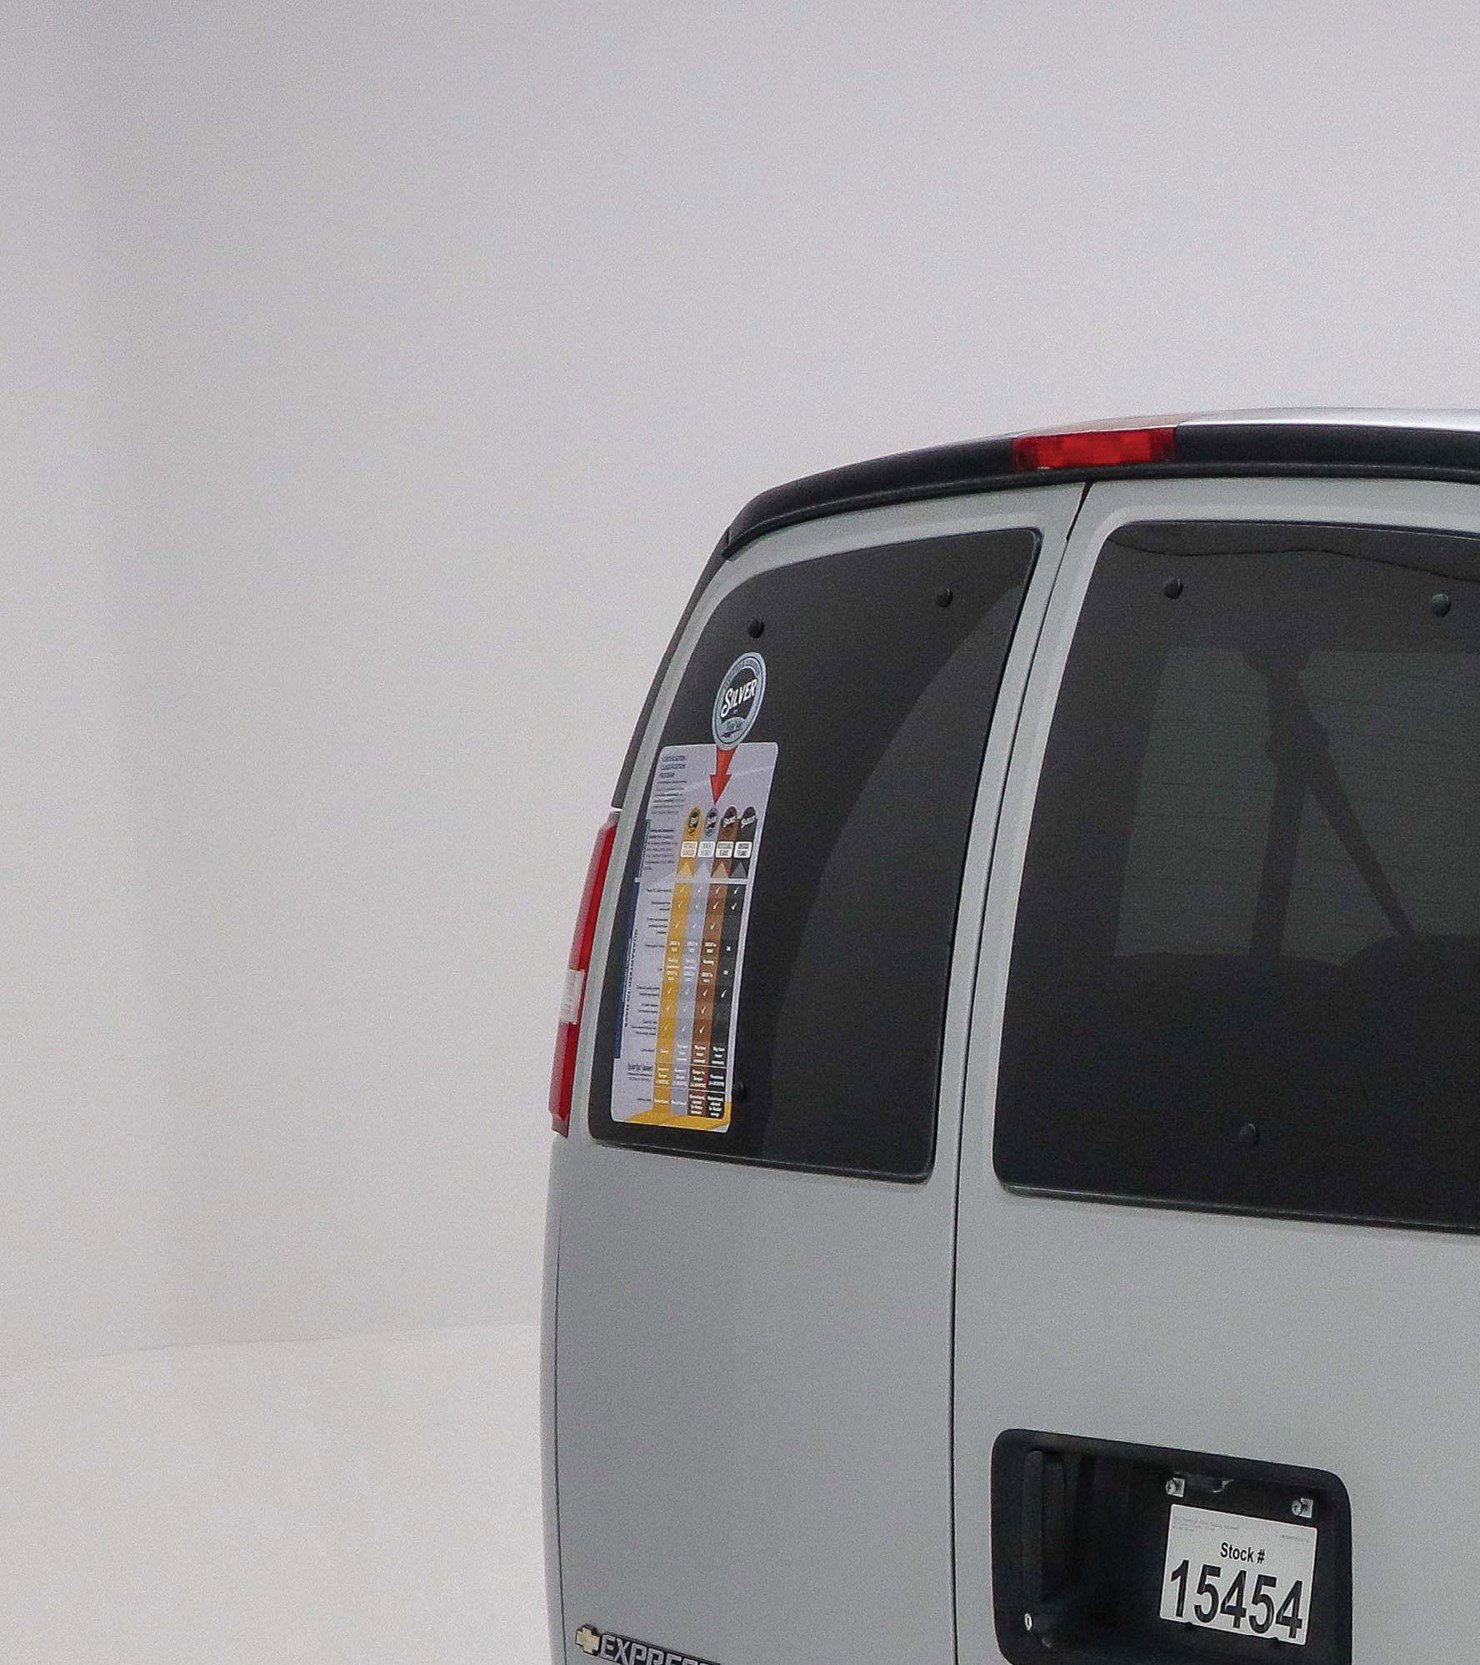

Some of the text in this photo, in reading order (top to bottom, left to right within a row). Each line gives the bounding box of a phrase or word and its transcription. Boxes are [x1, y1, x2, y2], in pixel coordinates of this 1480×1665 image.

[721, 679, 757, 718] SILVER
[1220, 1542, 1265, 1564] Stock #
[1170, 1559, 1303, 1639] 15454
